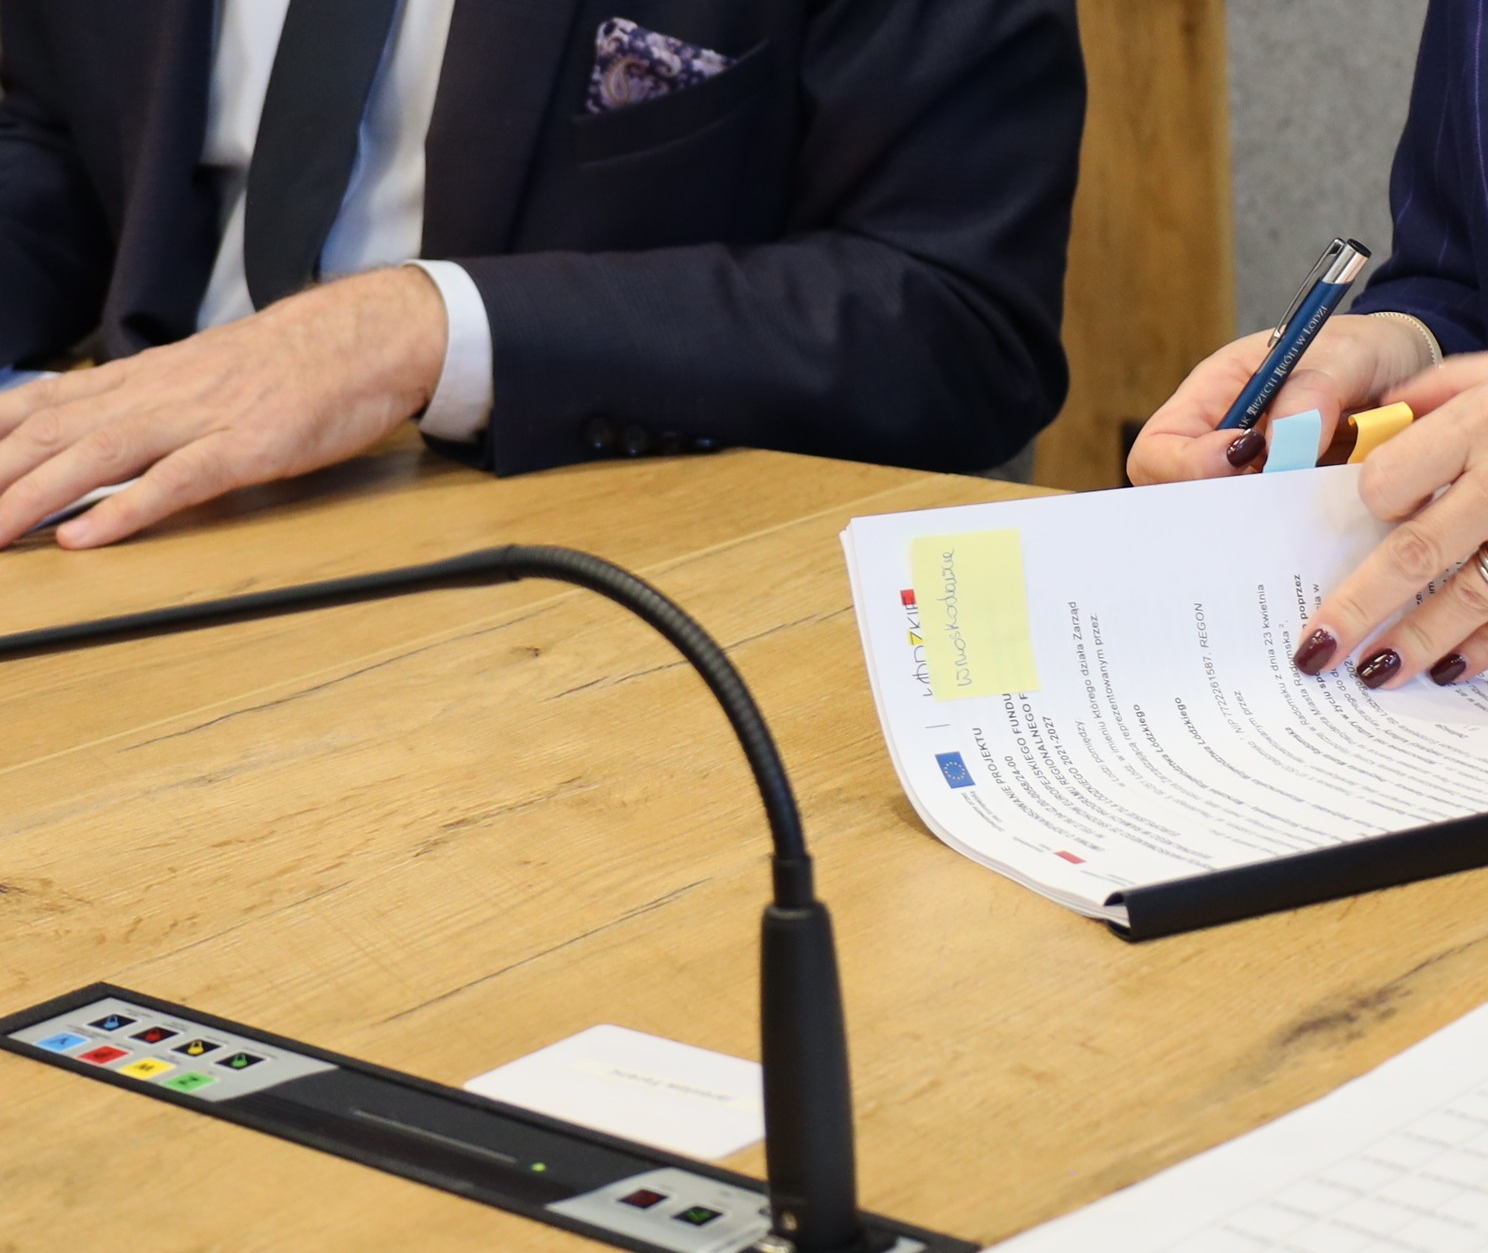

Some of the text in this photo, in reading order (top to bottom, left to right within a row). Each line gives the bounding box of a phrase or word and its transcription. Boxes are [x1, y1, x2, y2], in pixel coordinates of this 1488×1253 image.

[1256, 583, 1271, 629] kwietnia
[1293, 574, 1309, 620] poprzez
[1067, 601, 1084, 641] Zarząd
[1193, 602, 1210, 648] REGON
[1264, 631, 1275, 646] 23
[1077, 643, 1091, 677] działa
[1268, 649, 1280, 672] dnia
[1084, 679, 1102, 719] którego
[1095, 649, 1133, 741] reprezentowanym
[1277, 682, 1310, 727] Radomsku
[1301, 688, 1321, 716] Miasta
[1323, 691, 1345, 712] życiu
[1335, 680, 1351, 693] do
[1002, 692, 1022, 735] FUNDU
[1132, 703, 1164, 754] Łódzkiego
[1174, 696, 1207, 745] Łódzkiego
[971, 727, 1005, 785] PROJEKTU
[1022, 703, 1069, 787] REGIONALNEGO
[1042, 715, 1074, 767] 2021-2027
[1098, 721, 1120, 754] imieniu
[1016, 737, 1074, 806] EUROPEJSKIEGO
